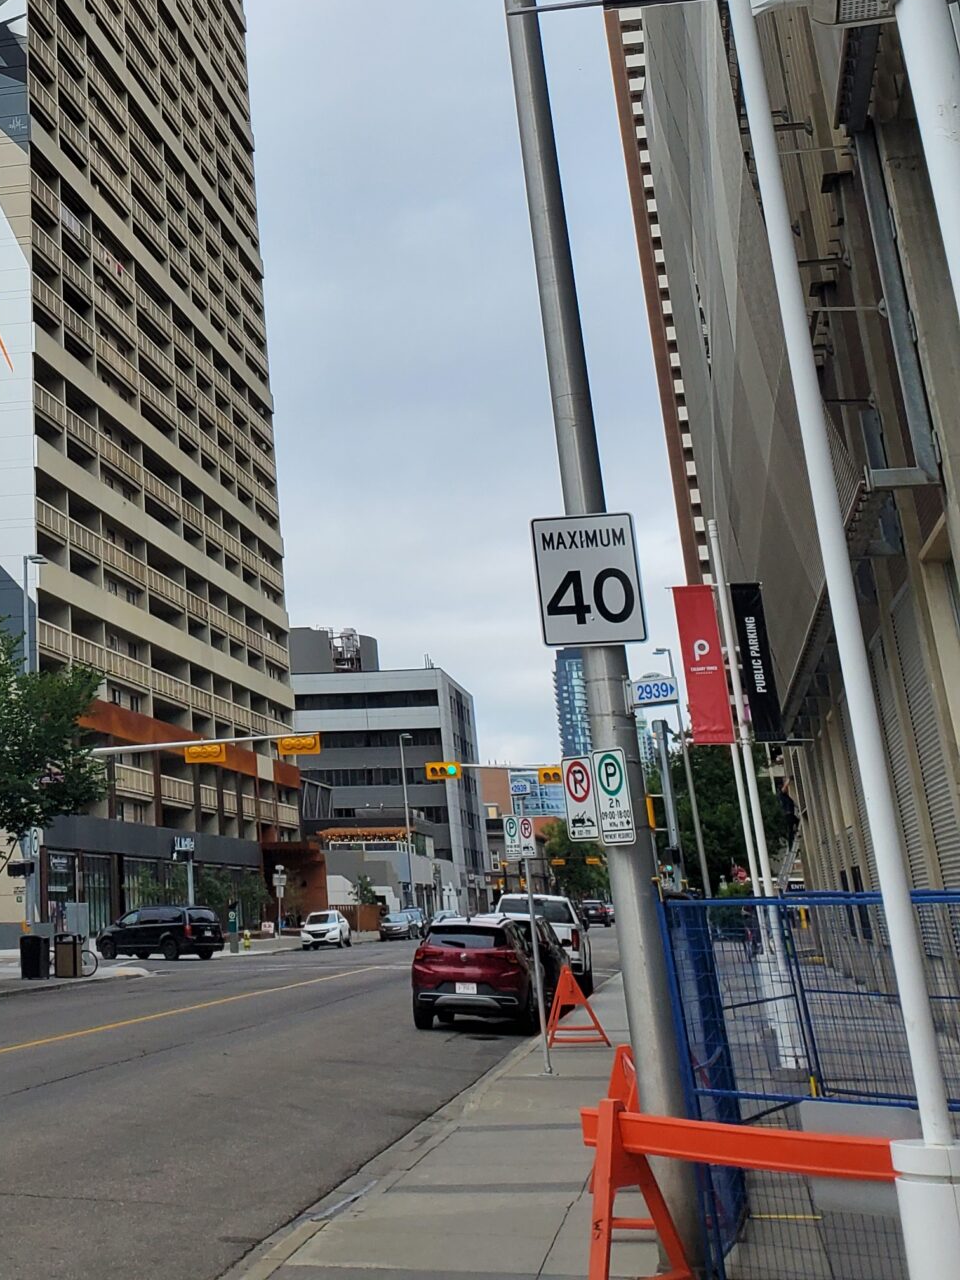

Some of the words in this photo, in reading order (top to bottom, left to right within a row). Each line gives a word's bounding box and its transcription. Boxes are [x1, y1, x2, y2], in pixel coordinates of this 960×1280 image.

[541, 527, 626, 551] MAXIMUM
[546, 567, 635, 625] 40
[744, 616, 761, 657] PARKING
[637, 681, 669, 700] 2939
[751, 659, 768, 693] PUBLIC
[604, 762, 617, 788] P
